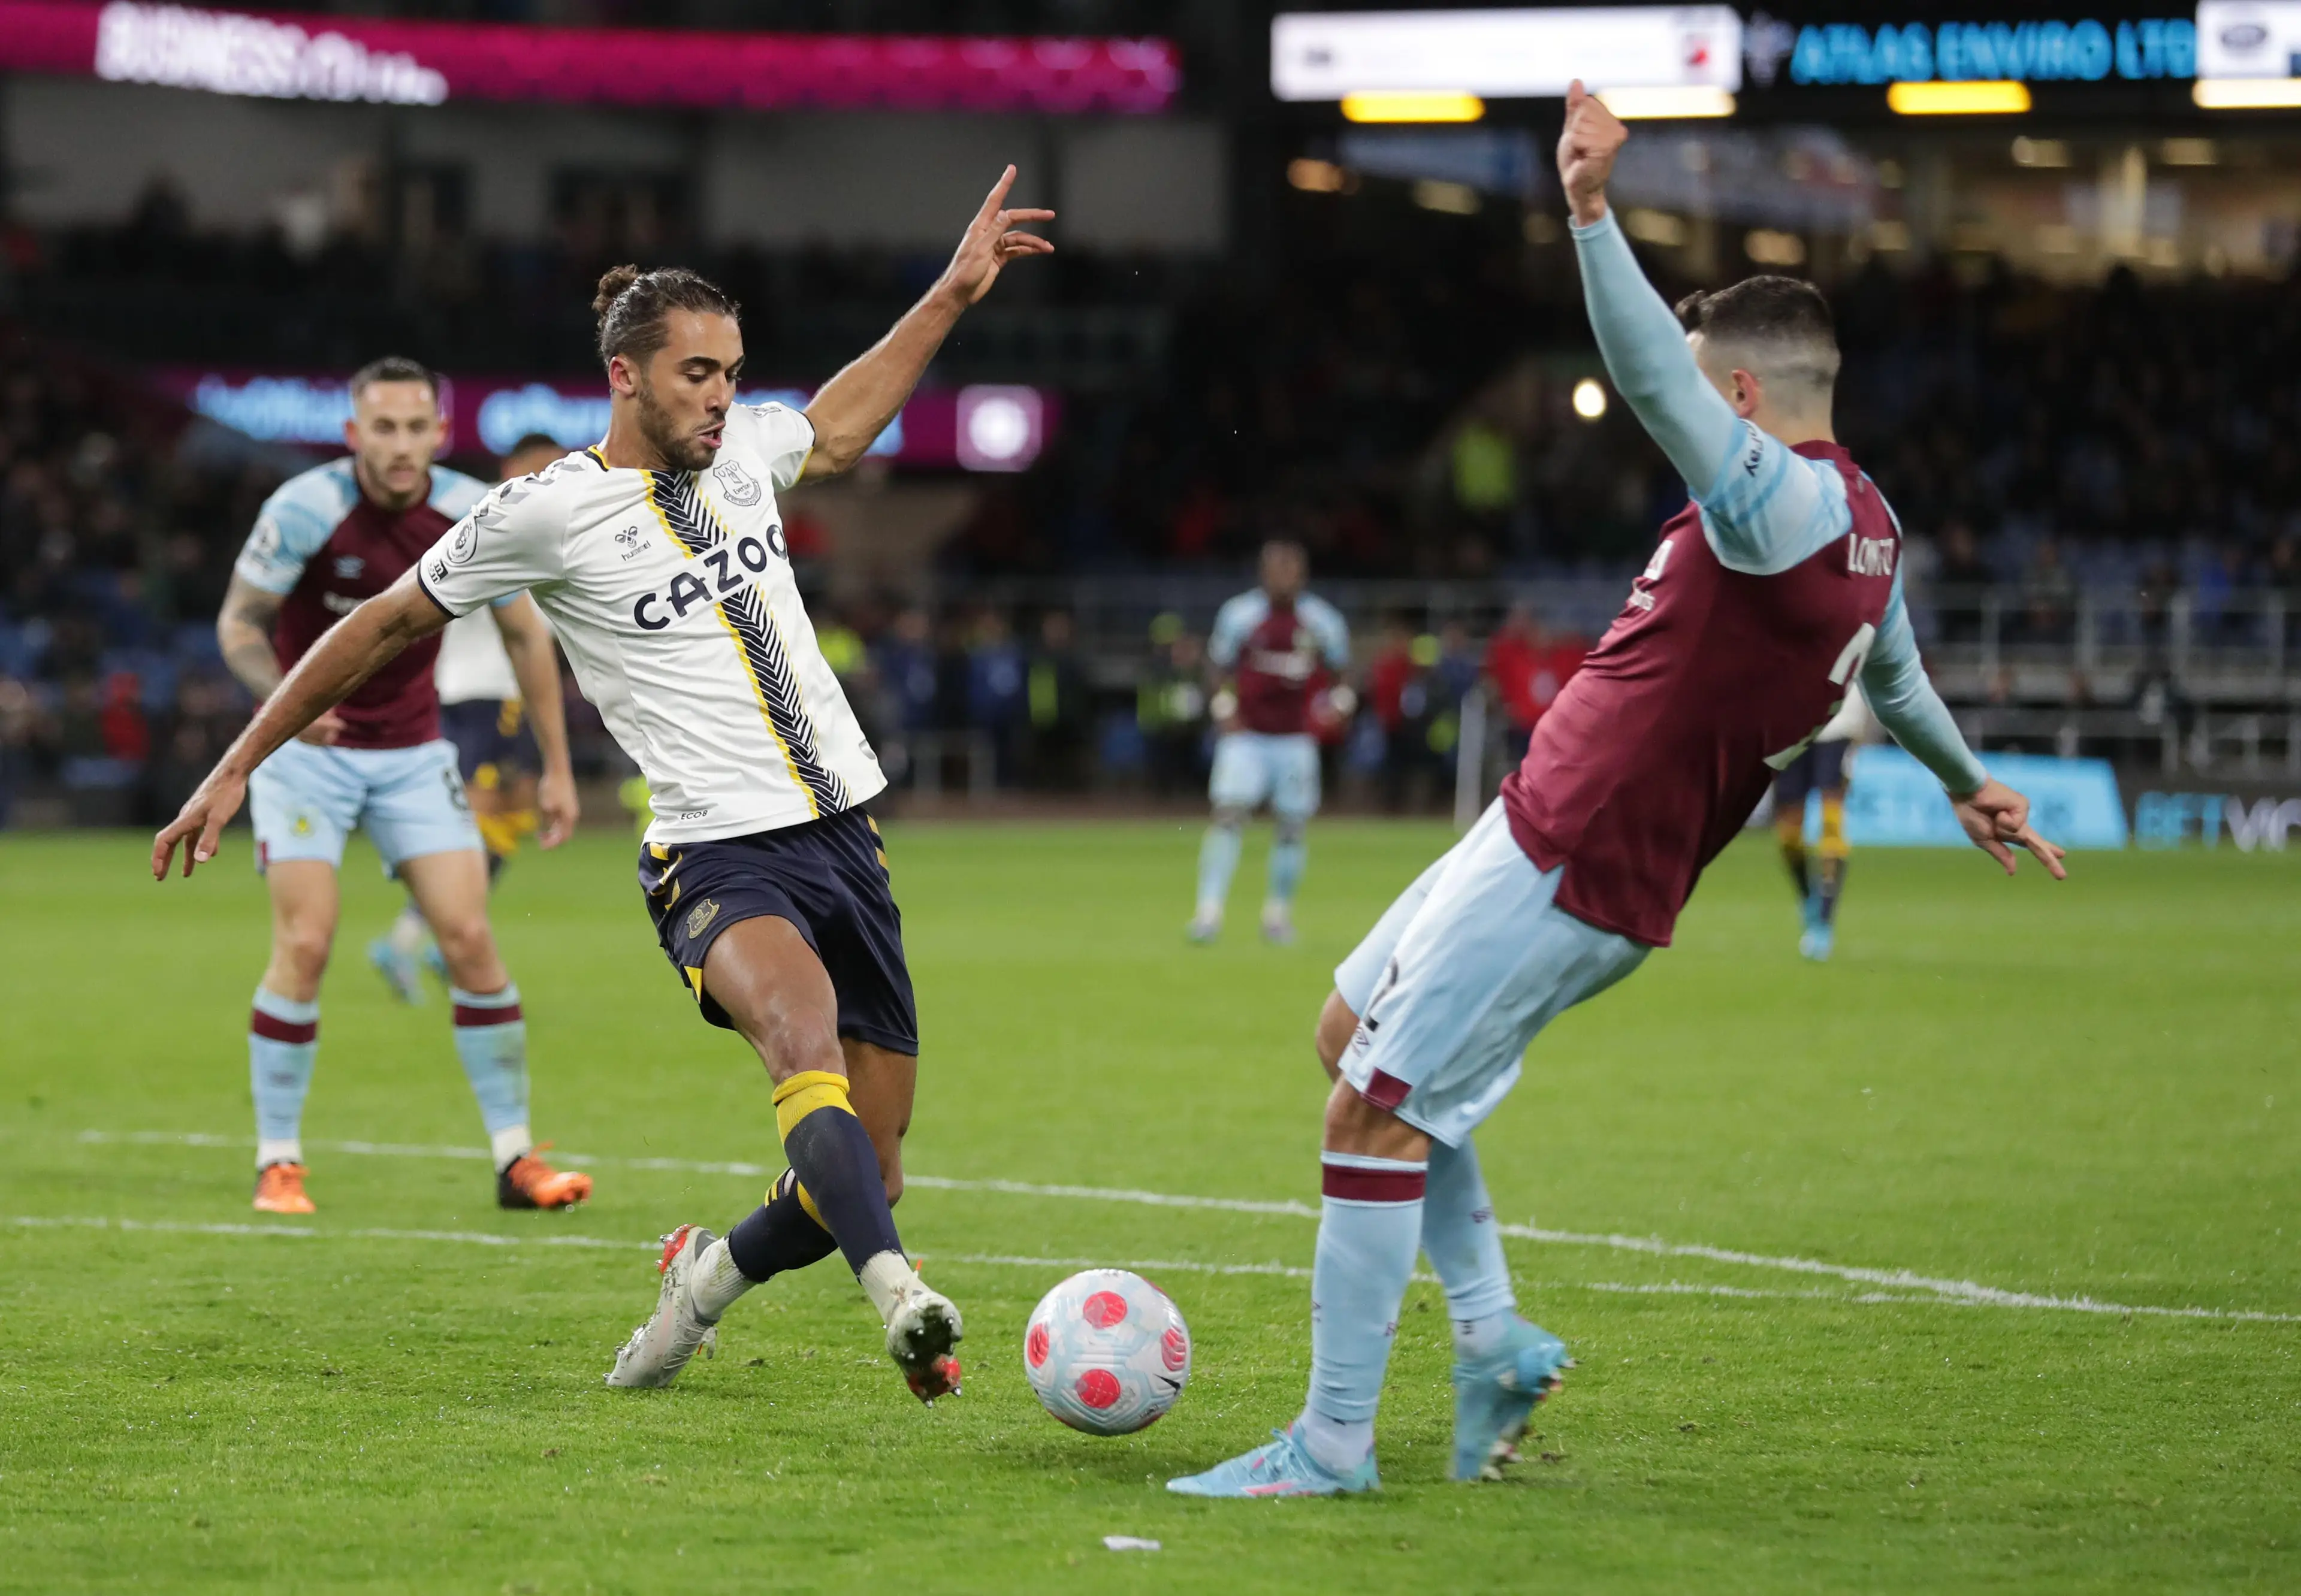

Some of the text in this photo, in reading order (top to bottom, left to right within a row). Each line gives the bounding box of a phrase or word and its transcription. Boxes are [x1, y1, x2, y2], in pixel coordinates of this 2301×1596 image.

[621, 540, 651, 561] hummel
[633, 524, 787, 630] CAZOO
[681, 810, 708, 820] ECO8
